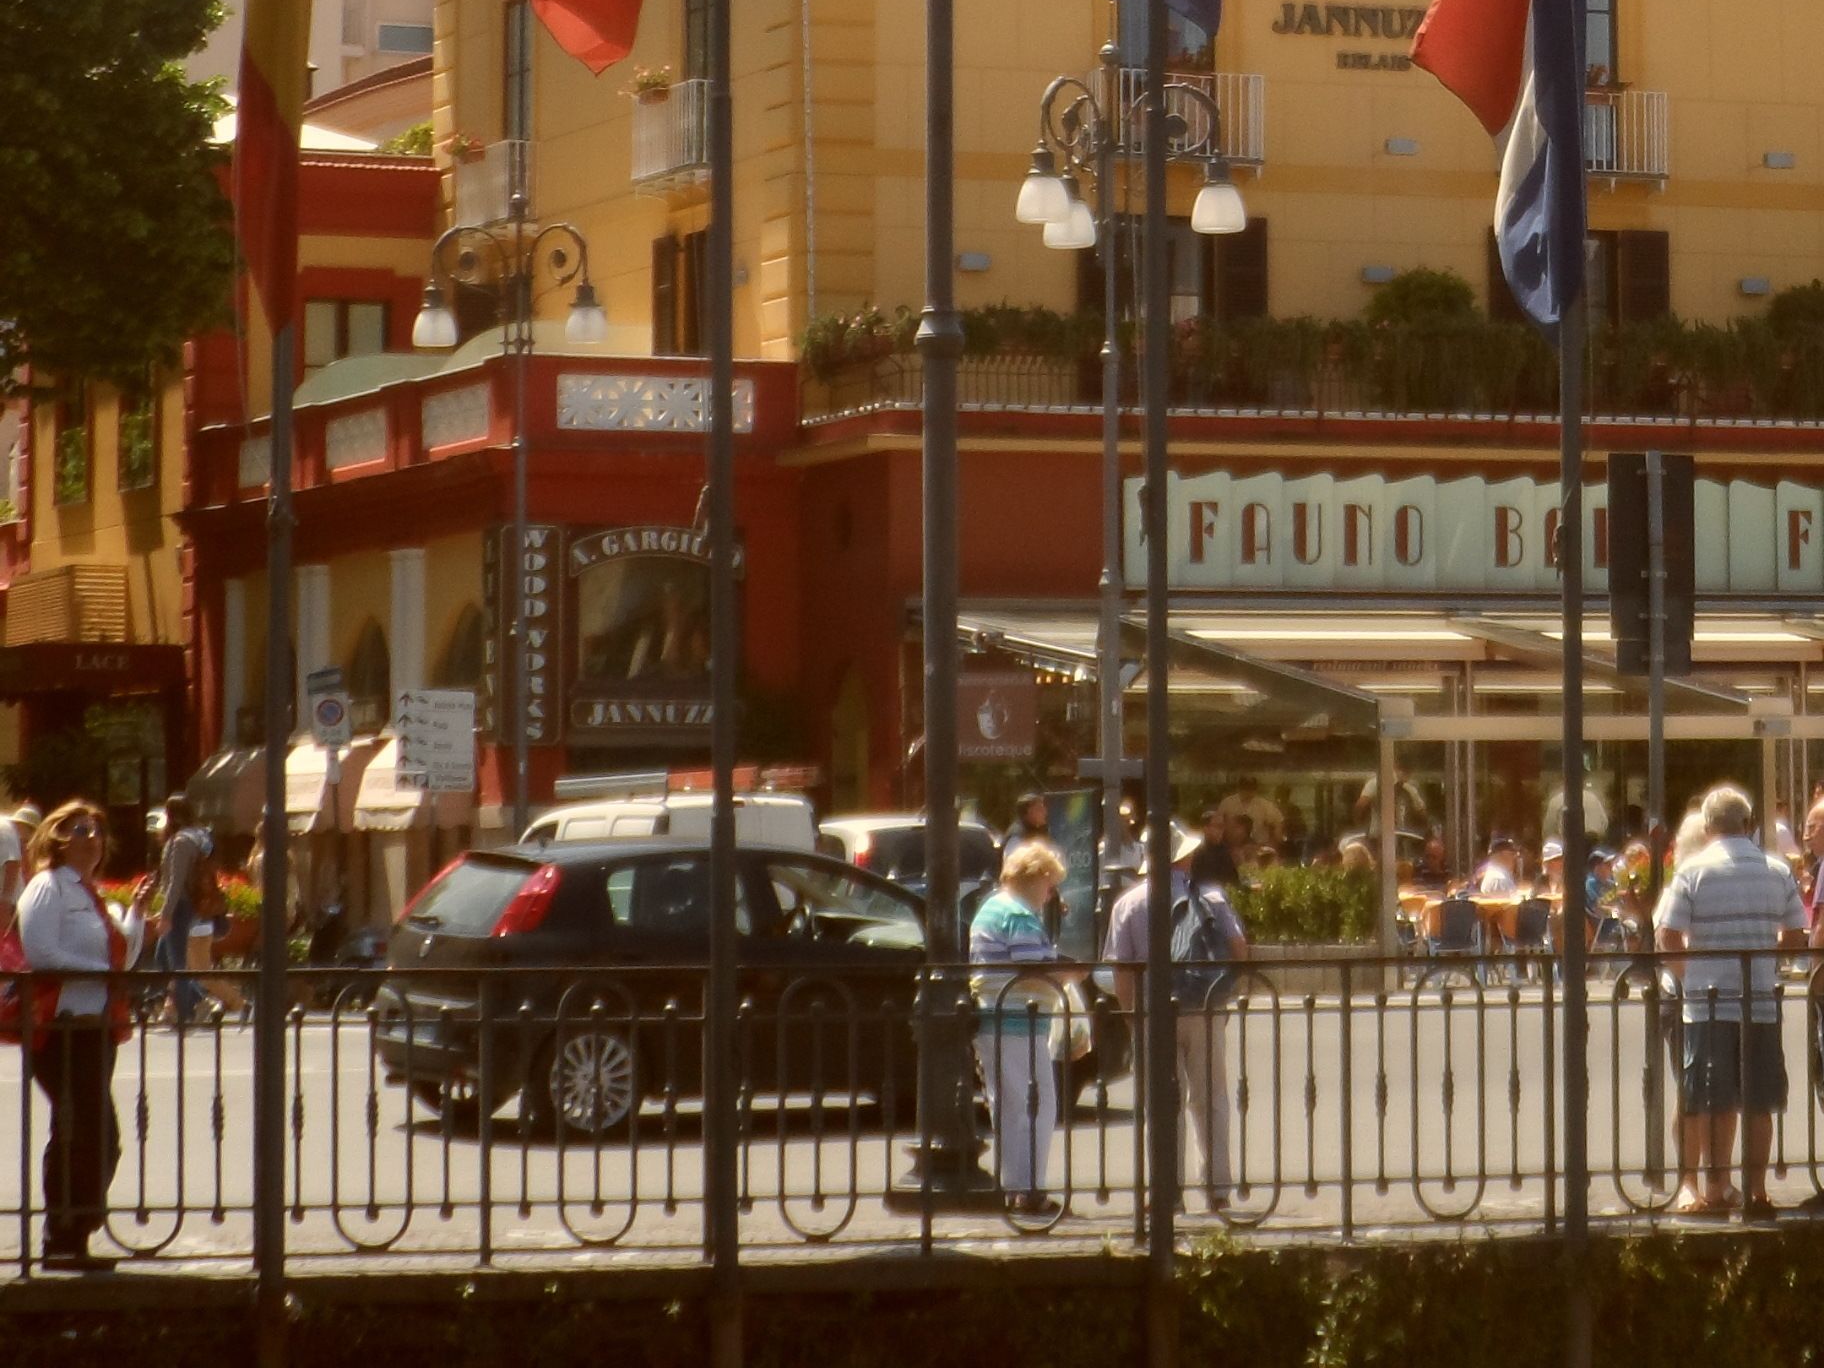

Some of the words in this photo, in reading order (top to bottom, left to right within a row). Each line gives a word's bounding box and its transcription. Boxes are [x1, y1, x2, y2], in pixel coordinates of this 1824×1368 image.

[1271, 3, 1428, 40] JANNUZ
[1188, 501, 1424, 567] FAUNO
[587, 703, 715, 725] JANNUZZ
